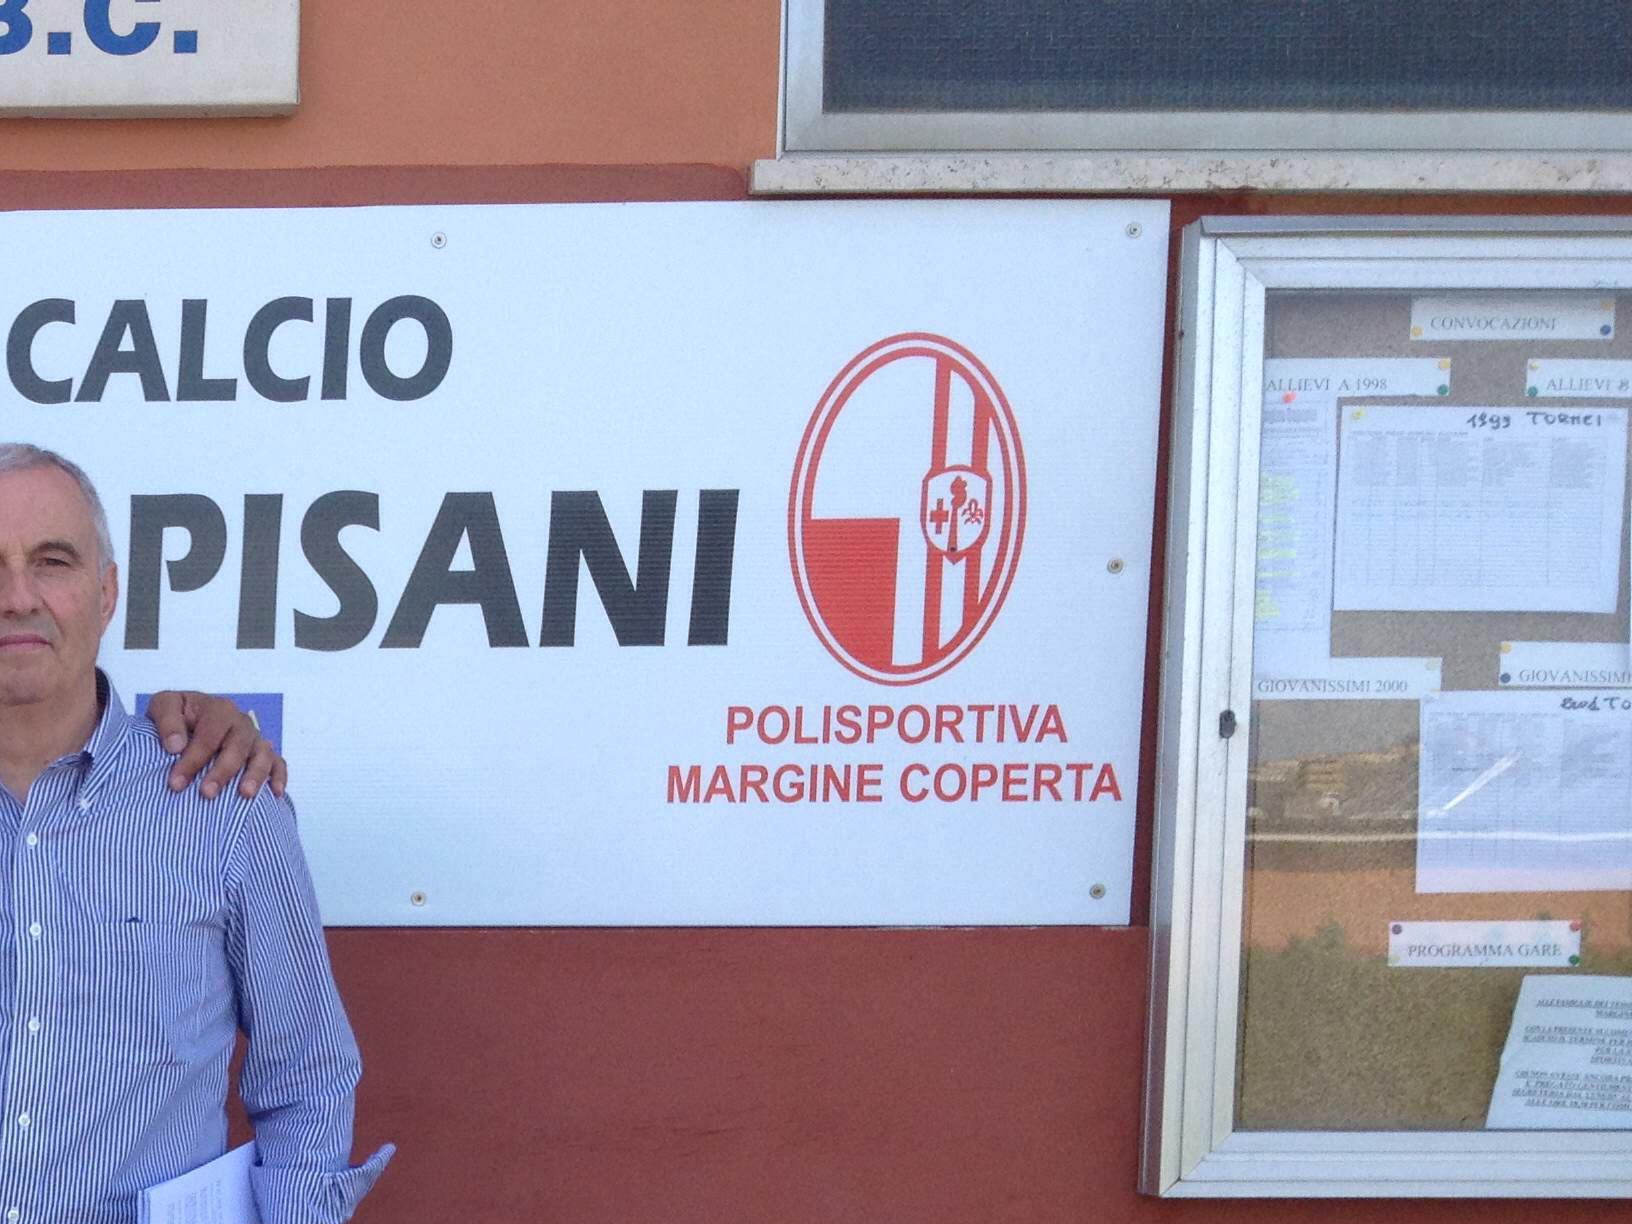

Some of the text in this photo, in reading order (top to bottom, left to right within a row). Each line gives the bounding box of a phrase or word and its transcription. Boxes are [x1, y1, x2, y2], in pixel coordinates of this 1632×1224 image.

[1429, 316, 1558, 331] CONVOCAZIONI
[5, 294, 453, 404] CALCIO
[1266, 378, 1388, 392] ALLIEVI A 1998
[1545, 377, 1611, 392] ALLIEVI
[122, 488, 740, 652] PISANI
[1257, 678, 1409, 693] GIOVANISSIMI 2000
[725, 703, 1069, 745] POLISPORTIVA
[666, 762, 1123, 804] MARGINE COPERTA
[1408, 943, 1563, 958] PROGRAMMA GARE
